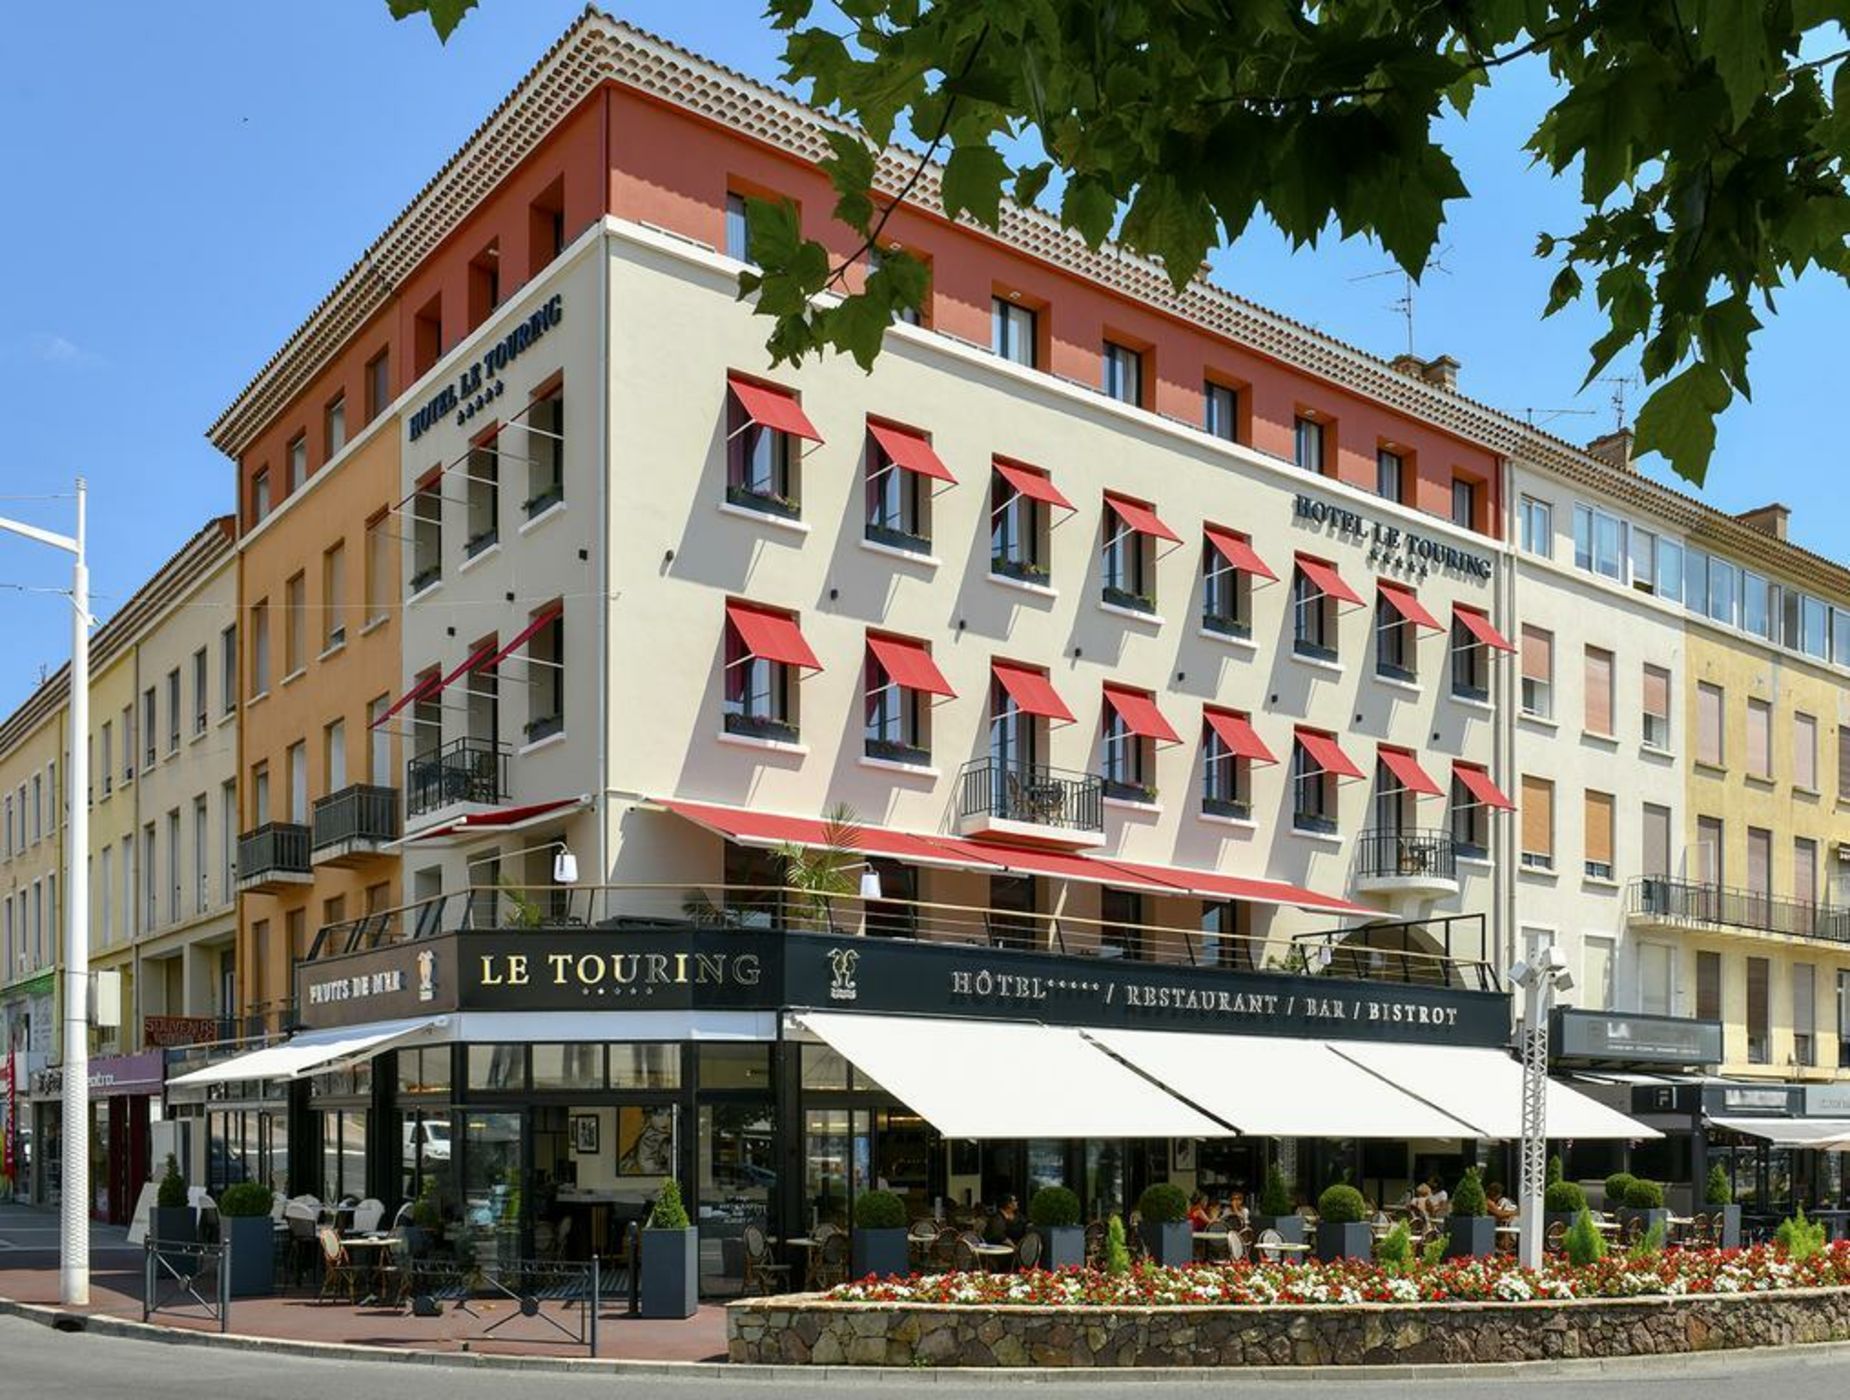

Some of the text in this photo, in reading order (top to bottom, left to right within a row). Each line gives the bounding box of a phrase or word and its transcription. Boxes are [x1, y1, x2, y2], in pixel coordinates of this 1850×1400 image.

[460, 362, 482, 399] LE
[484, 293, 563, 379] TOURING
[1295, 494, 1492, 579] HOTEL LE TOURING
[480, 954, 760, 984] LE TOURING
[309, 979, 349, 1004] FRUITS
[351, 976, 369, 997] DE
[1127, 985, 1278, 1014] RESTAURANT
[1306, 998, 1346, 1018] BAR
[1369, 1002, 1457, 1025] BISTROT
